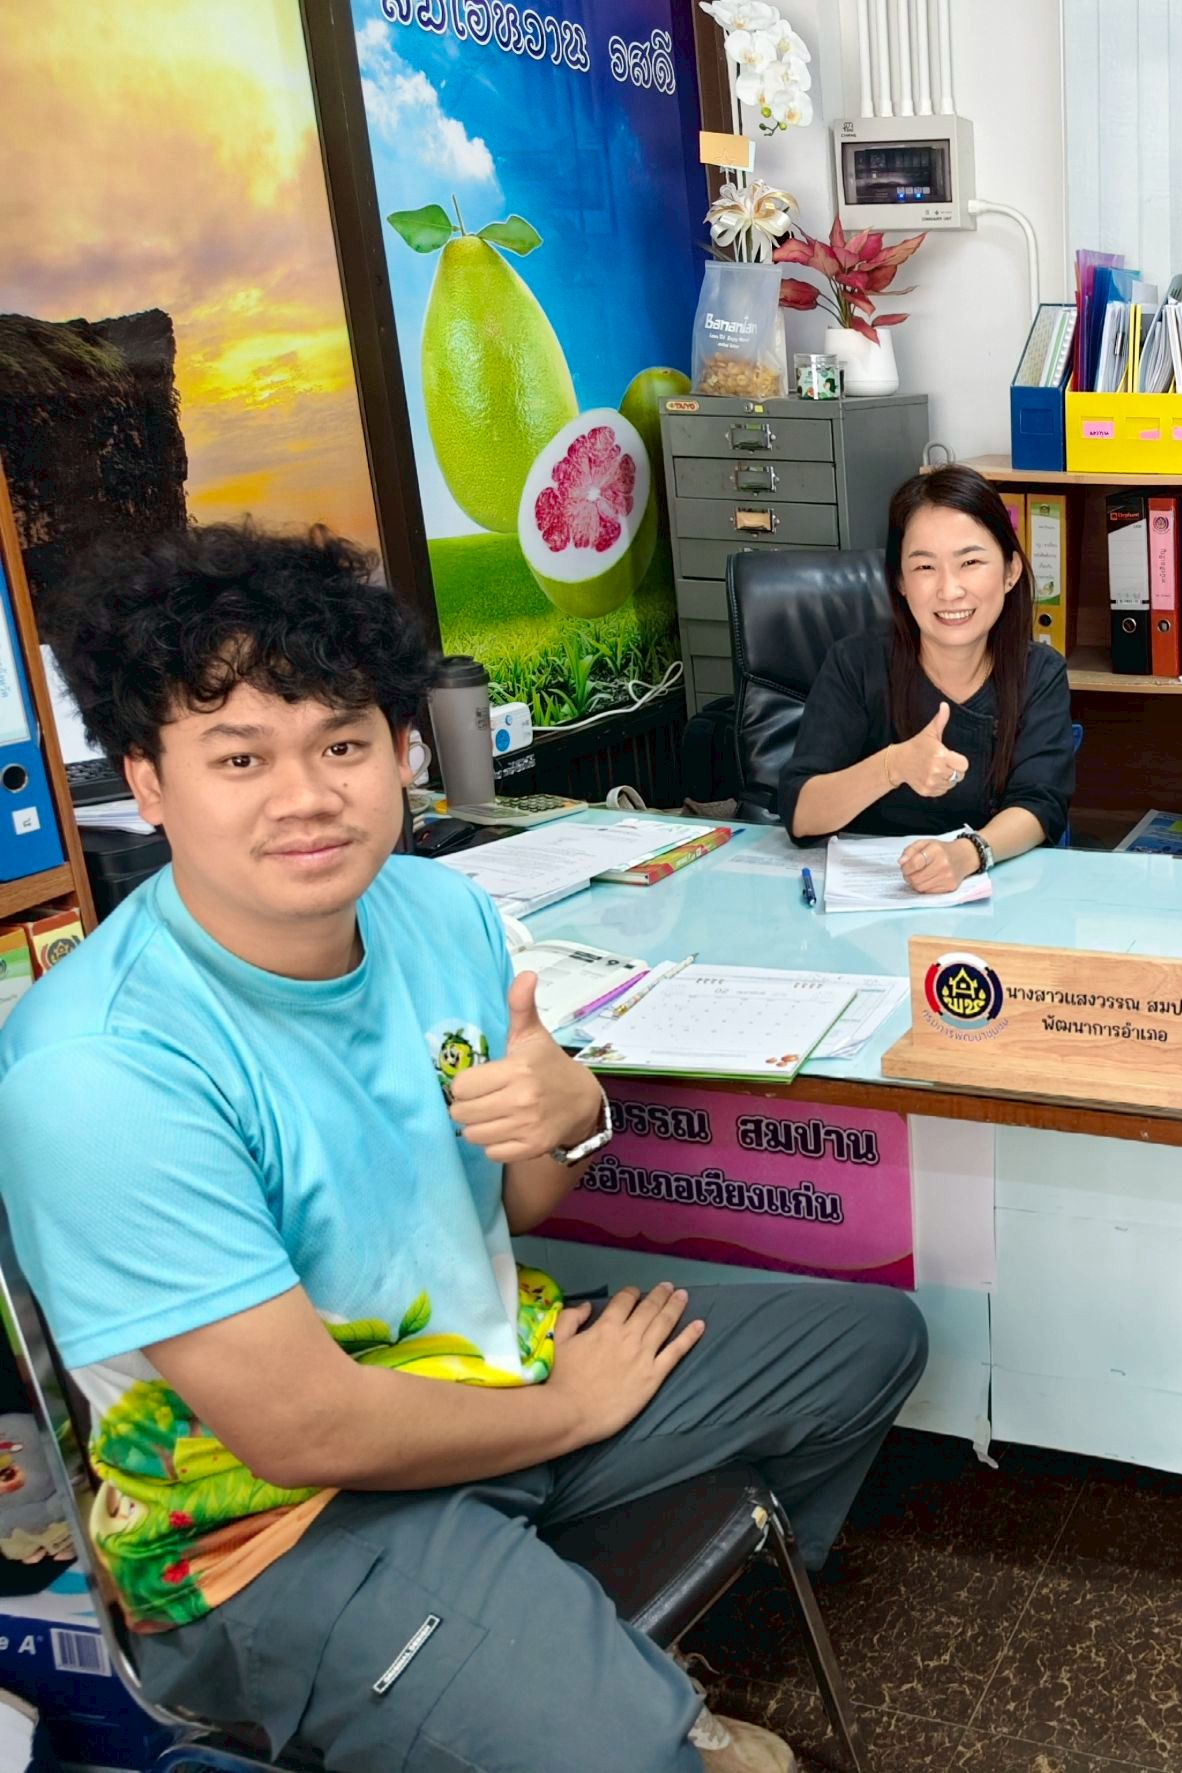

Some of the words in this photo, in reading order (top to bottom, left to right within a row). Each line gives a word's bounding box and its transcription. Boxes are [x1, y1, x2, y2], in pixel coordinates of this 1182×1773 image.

[608, 29, 676, 95] รสดี
[1006, 985, 1141, 1012] นางสาวแสงวรรณ
[1041, 1015, 1168, 1043] พัฒนาการอำเภอ
[737, 1113, 880, 1165] สมปาน
